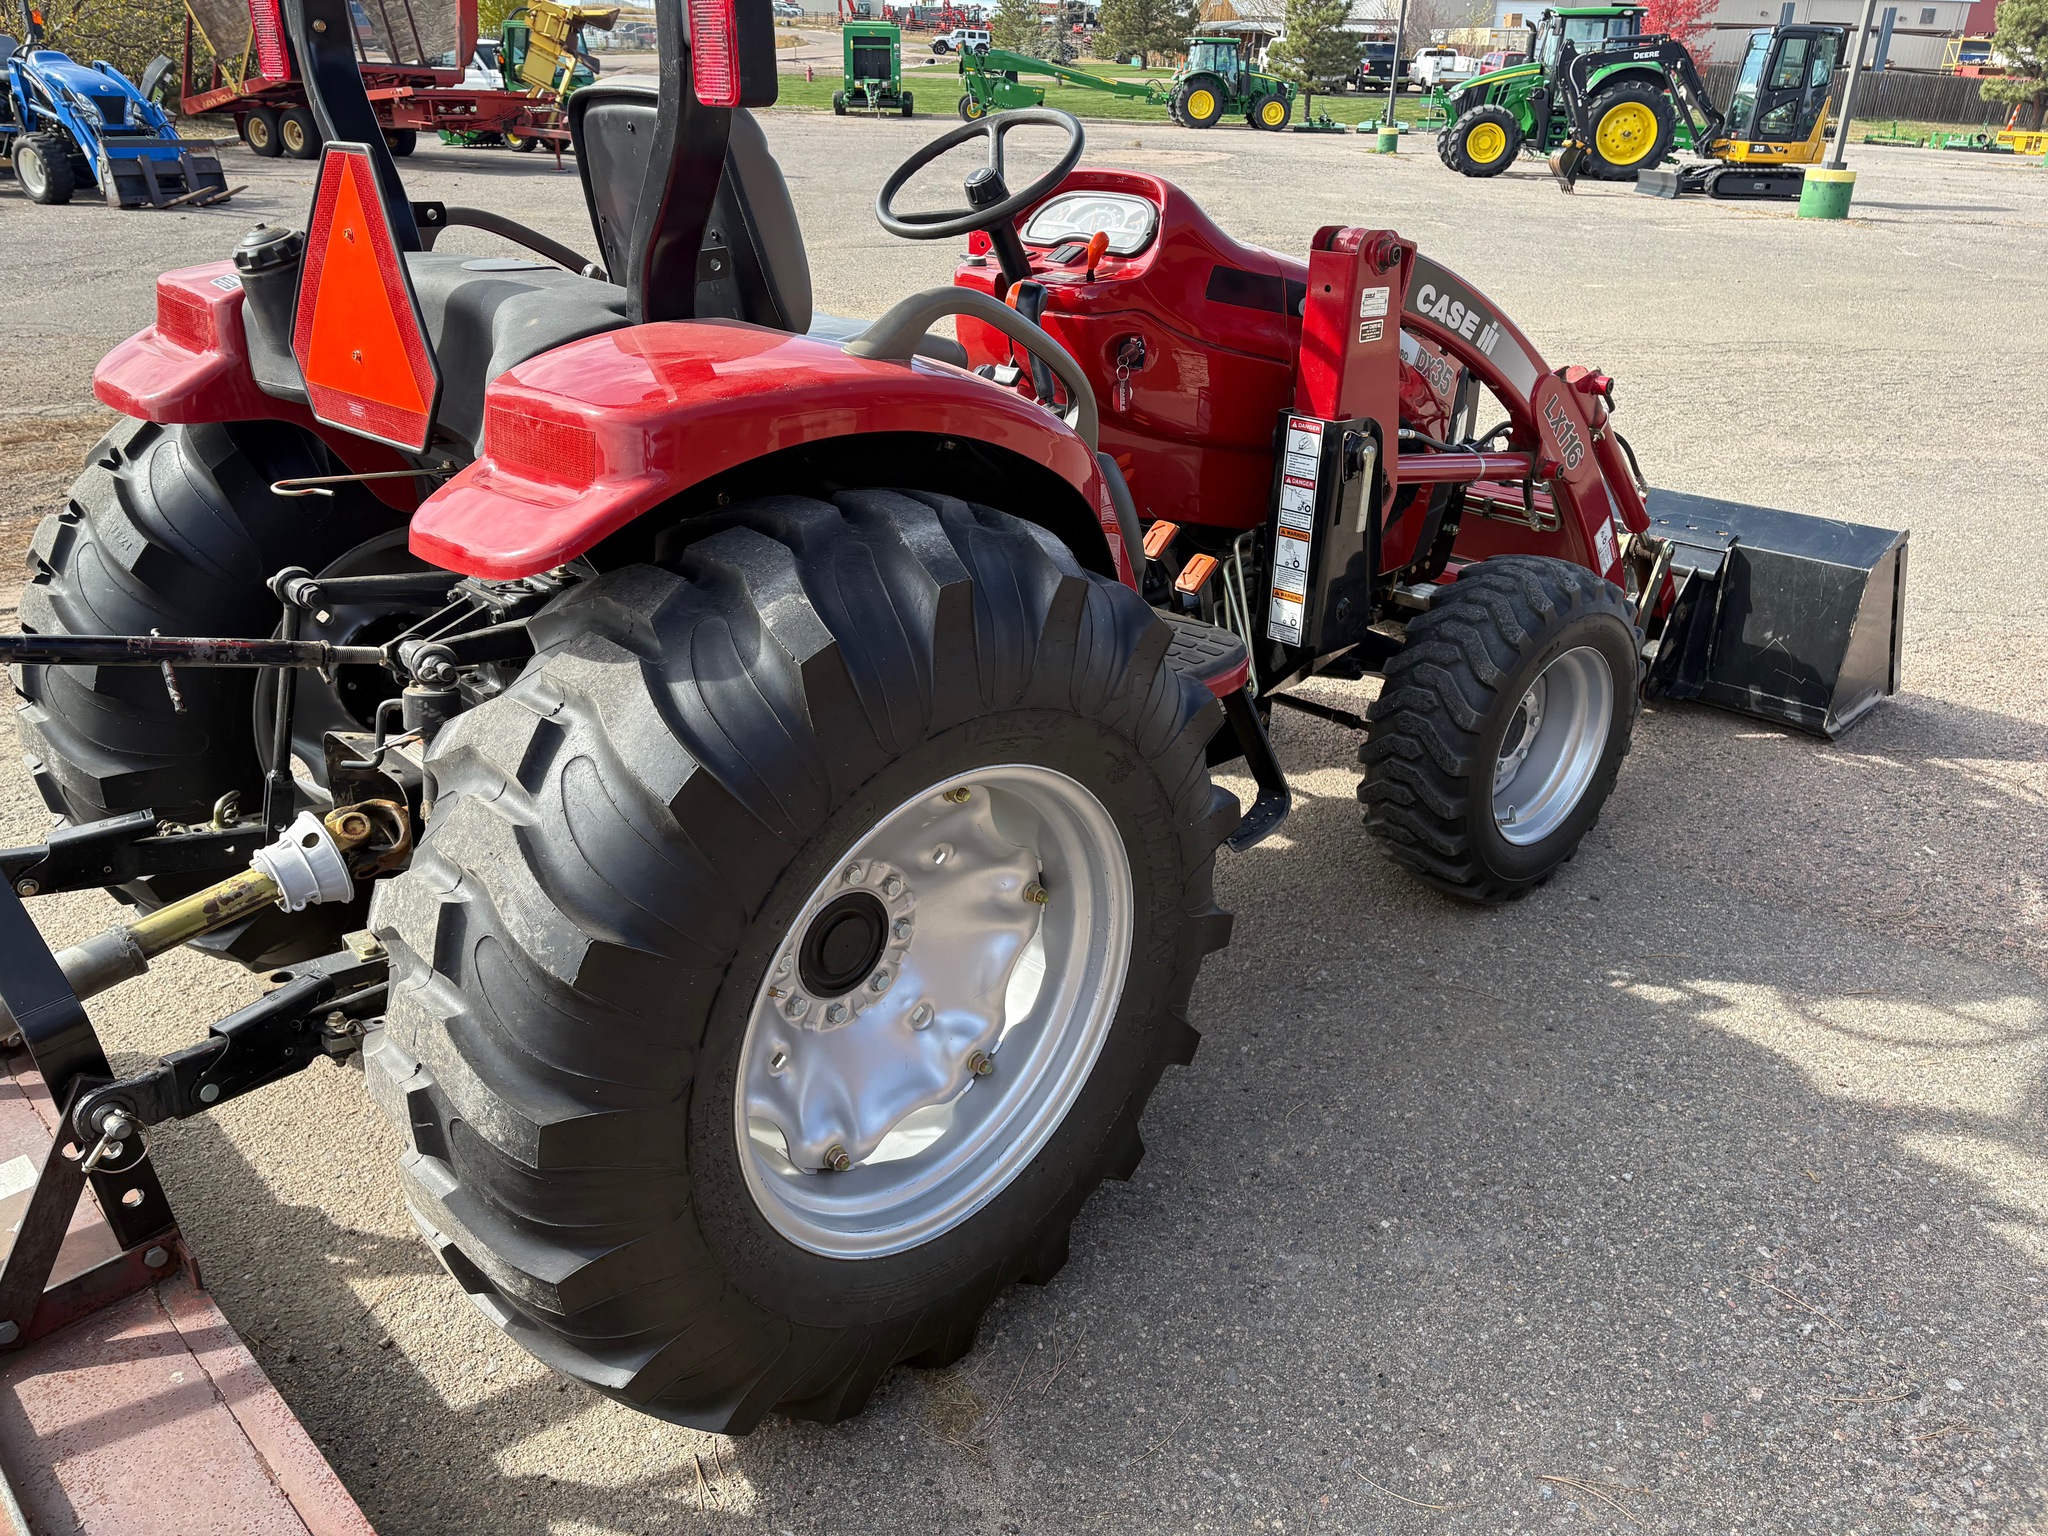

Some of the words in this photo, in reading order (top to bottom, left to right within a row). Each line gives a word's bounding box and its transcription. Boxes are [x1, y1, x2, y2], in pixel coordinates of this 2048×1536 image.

[1633, 50, 1660, 60] DEERE
[1416, 284, 1481, 341] CASE
[1413, 345, 1455, 397] DX35
[1298, 422, 1321, 432] DANGER
[1543, 393, 1585, 470] LX116
[1291, 476, 1314, 487] DANGER
[1286, 529, 1308, 540] WARNING
[1280, 591, 1302, 602] WARNING
[1132, 798, 1180, 967] TITAN
